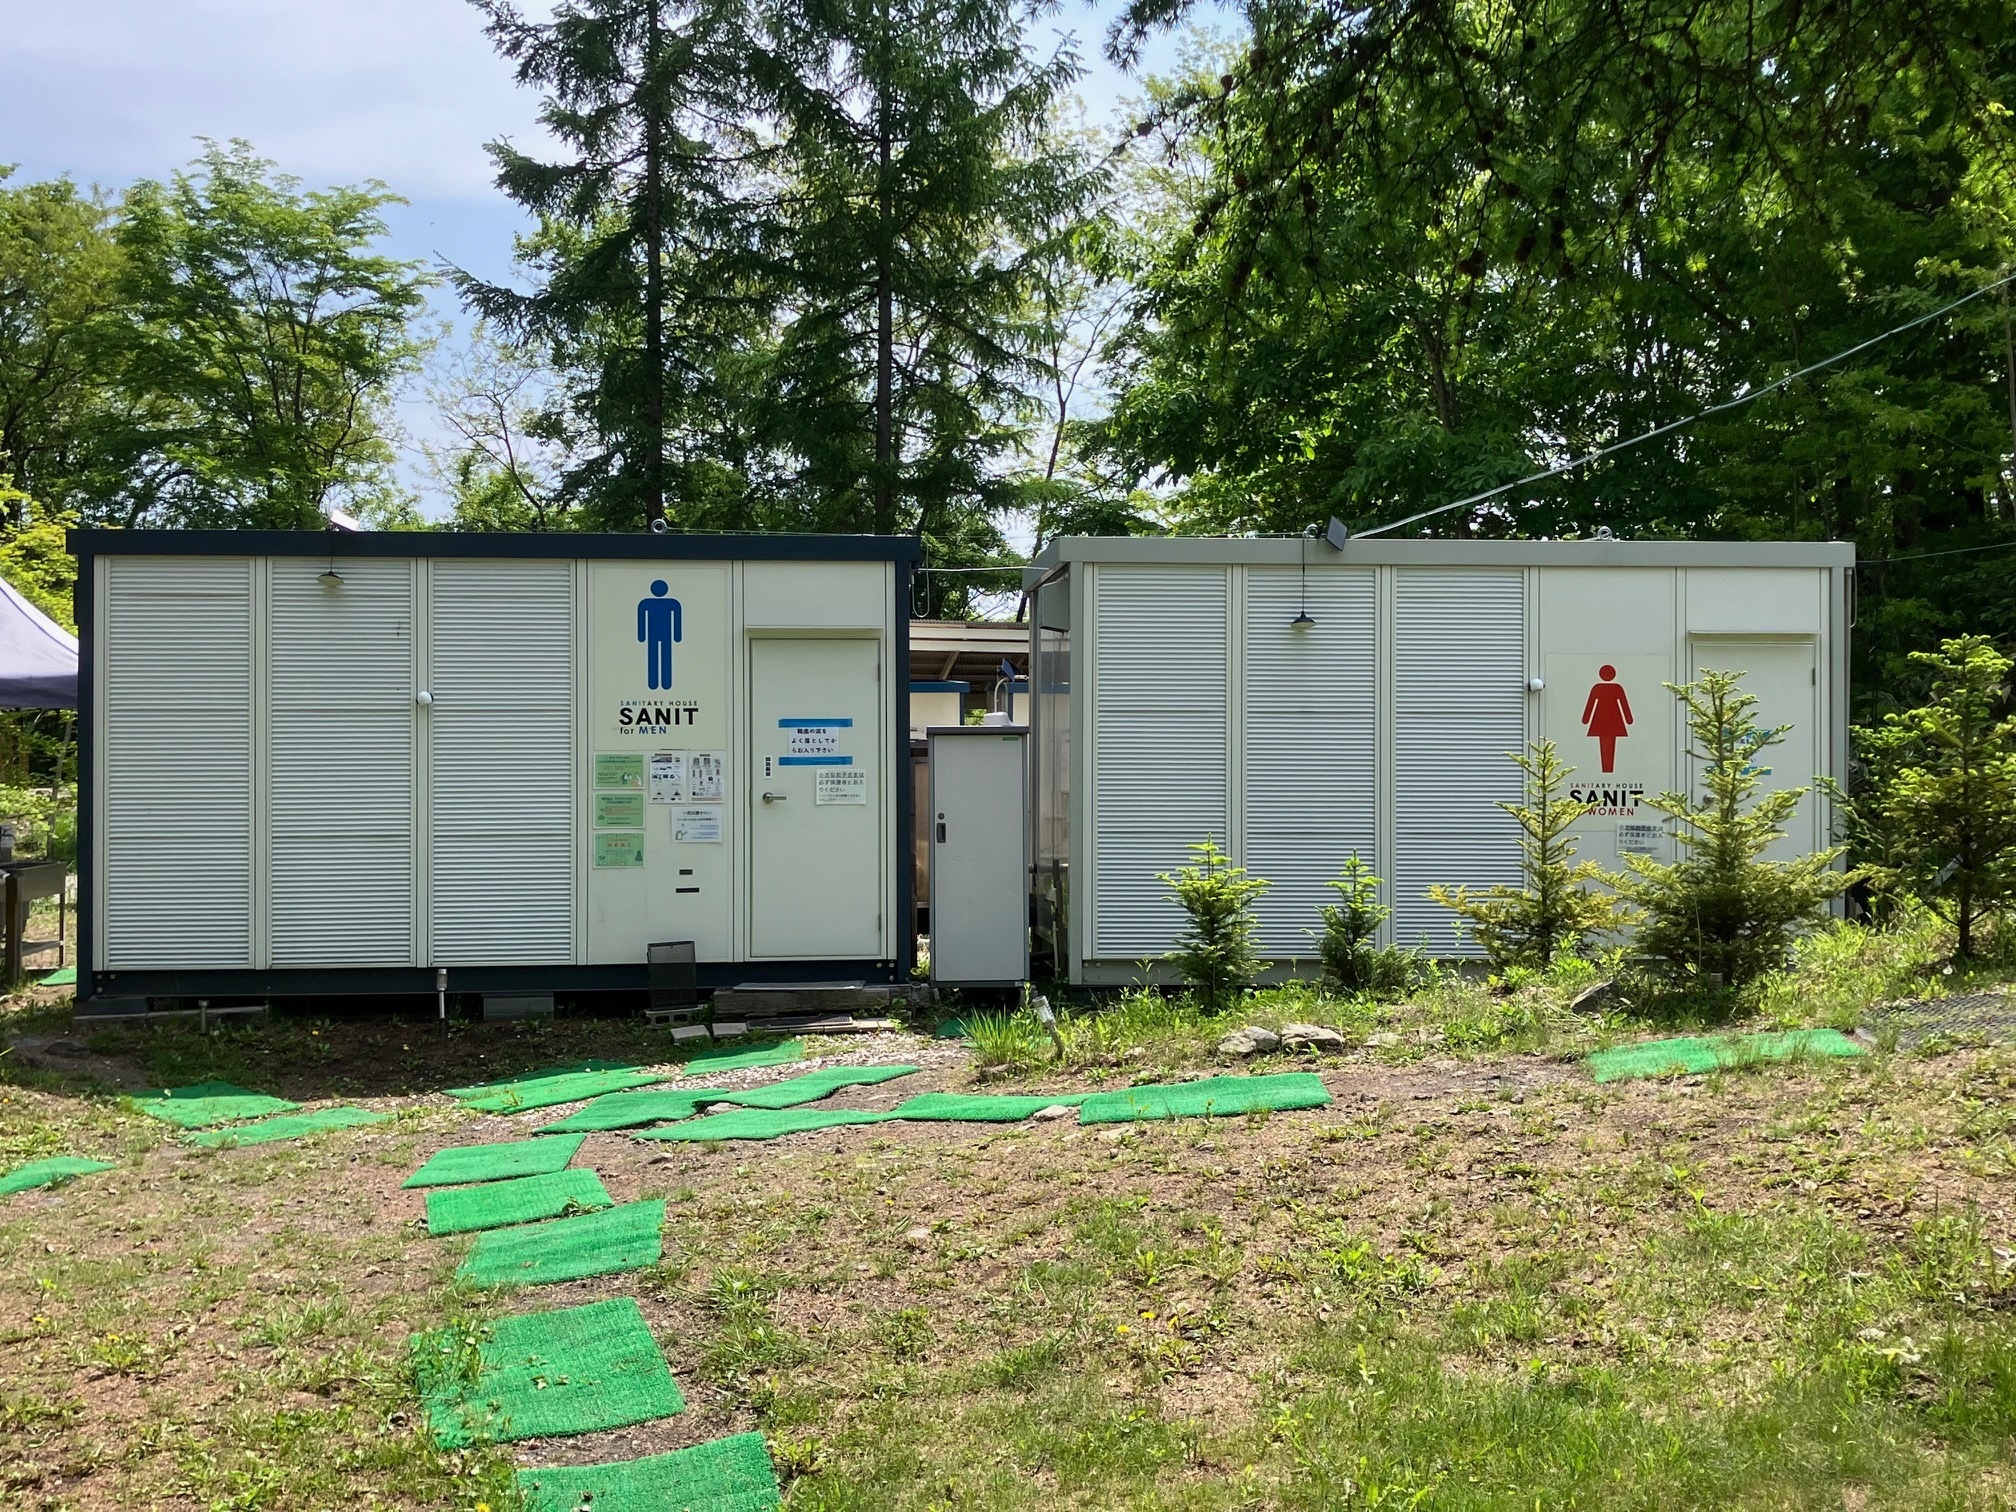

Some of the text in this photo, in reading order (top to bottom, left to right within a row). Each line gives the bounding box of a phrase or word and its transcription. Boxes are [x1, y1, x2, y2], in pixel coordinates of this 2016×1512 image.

[619, 707, 699, 726] SANIT
[620, 726, 667, 735] for MEN
[1569, 789, 1644, 807] SANIT
[1588, 807, 1634, 816] WOMEN
